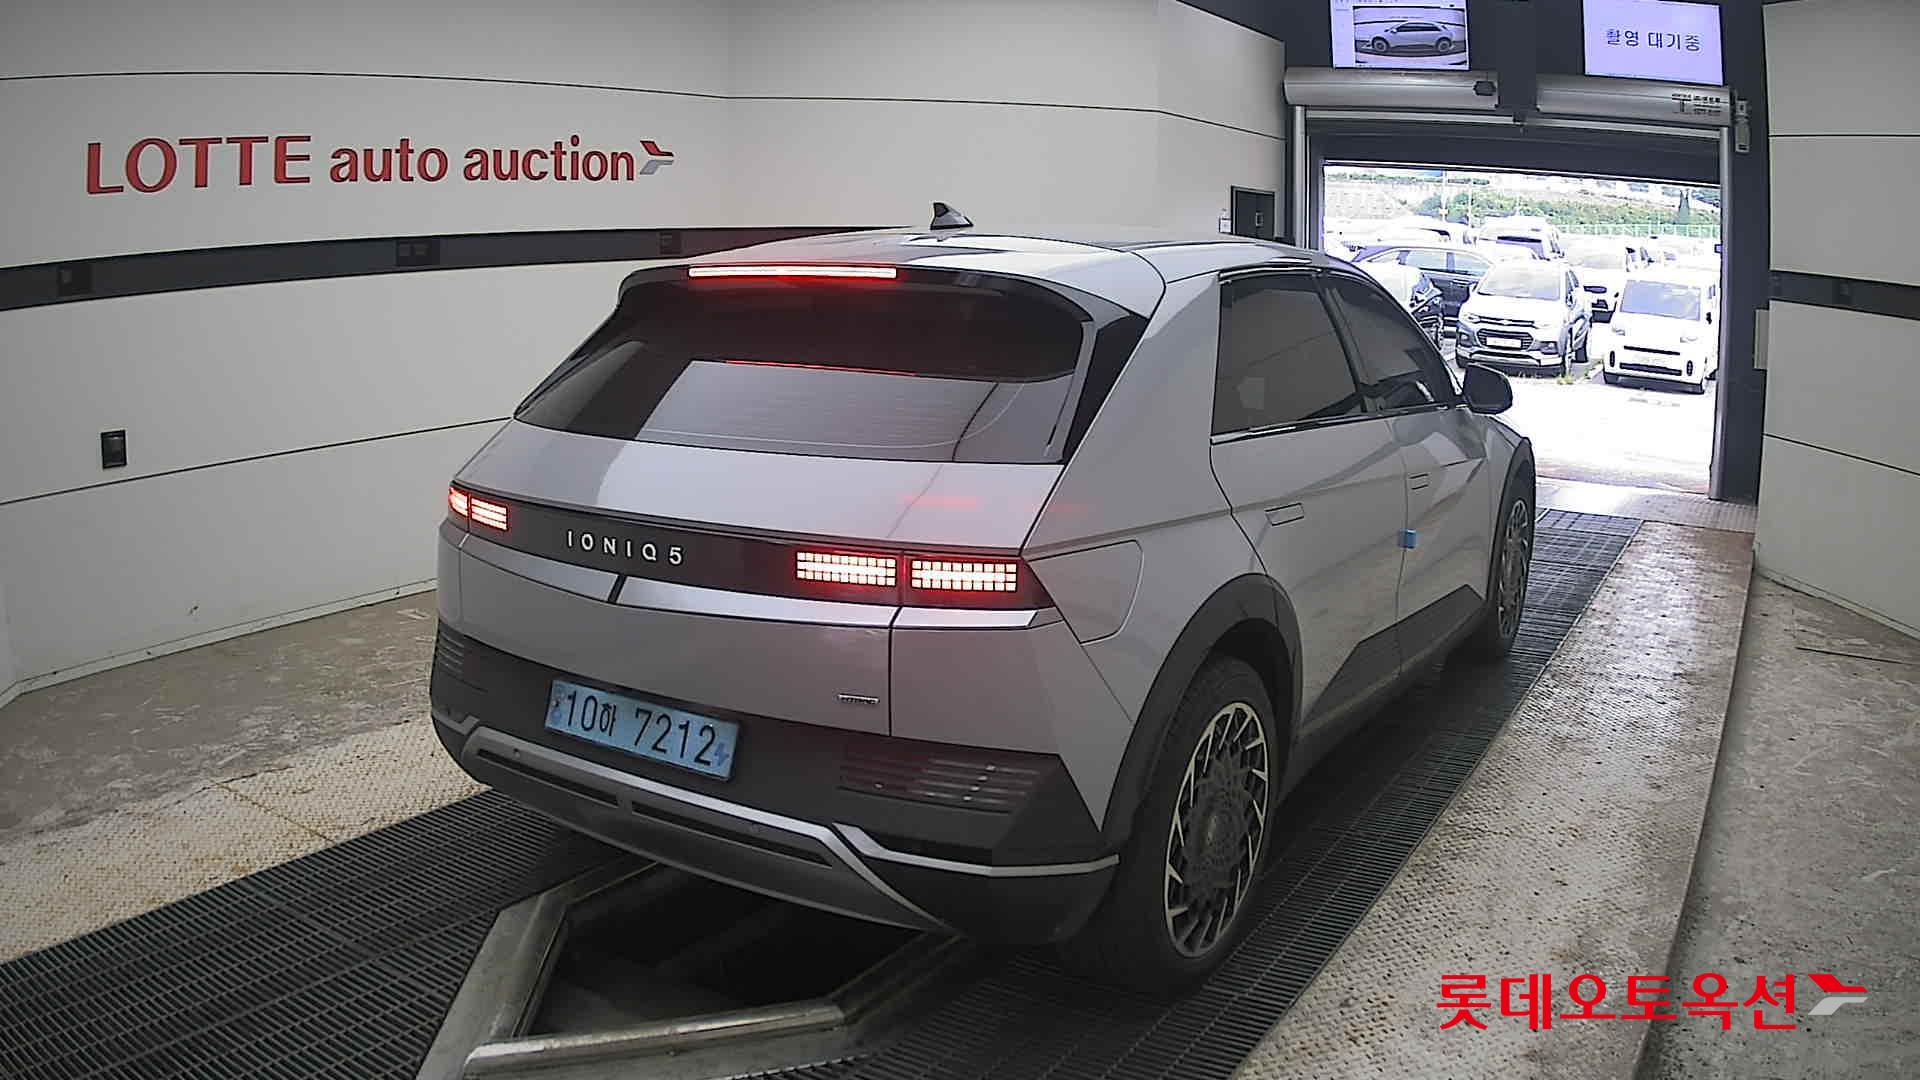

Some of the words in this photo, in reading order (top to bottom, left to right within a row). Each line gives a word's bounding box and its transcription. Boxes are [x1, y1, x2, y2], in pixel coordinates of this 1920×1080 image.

[1648, 32, 1700, 51] 대기중
[86, 135, 311, 194] LOTTE
[329, 138, 448, 183] auto
[463, 135, 635, 182] auction
[567, 530, 657, 561] IONIQ
[669, 547, 682, 565] 5
[634, 708, 716, 766] 7212
